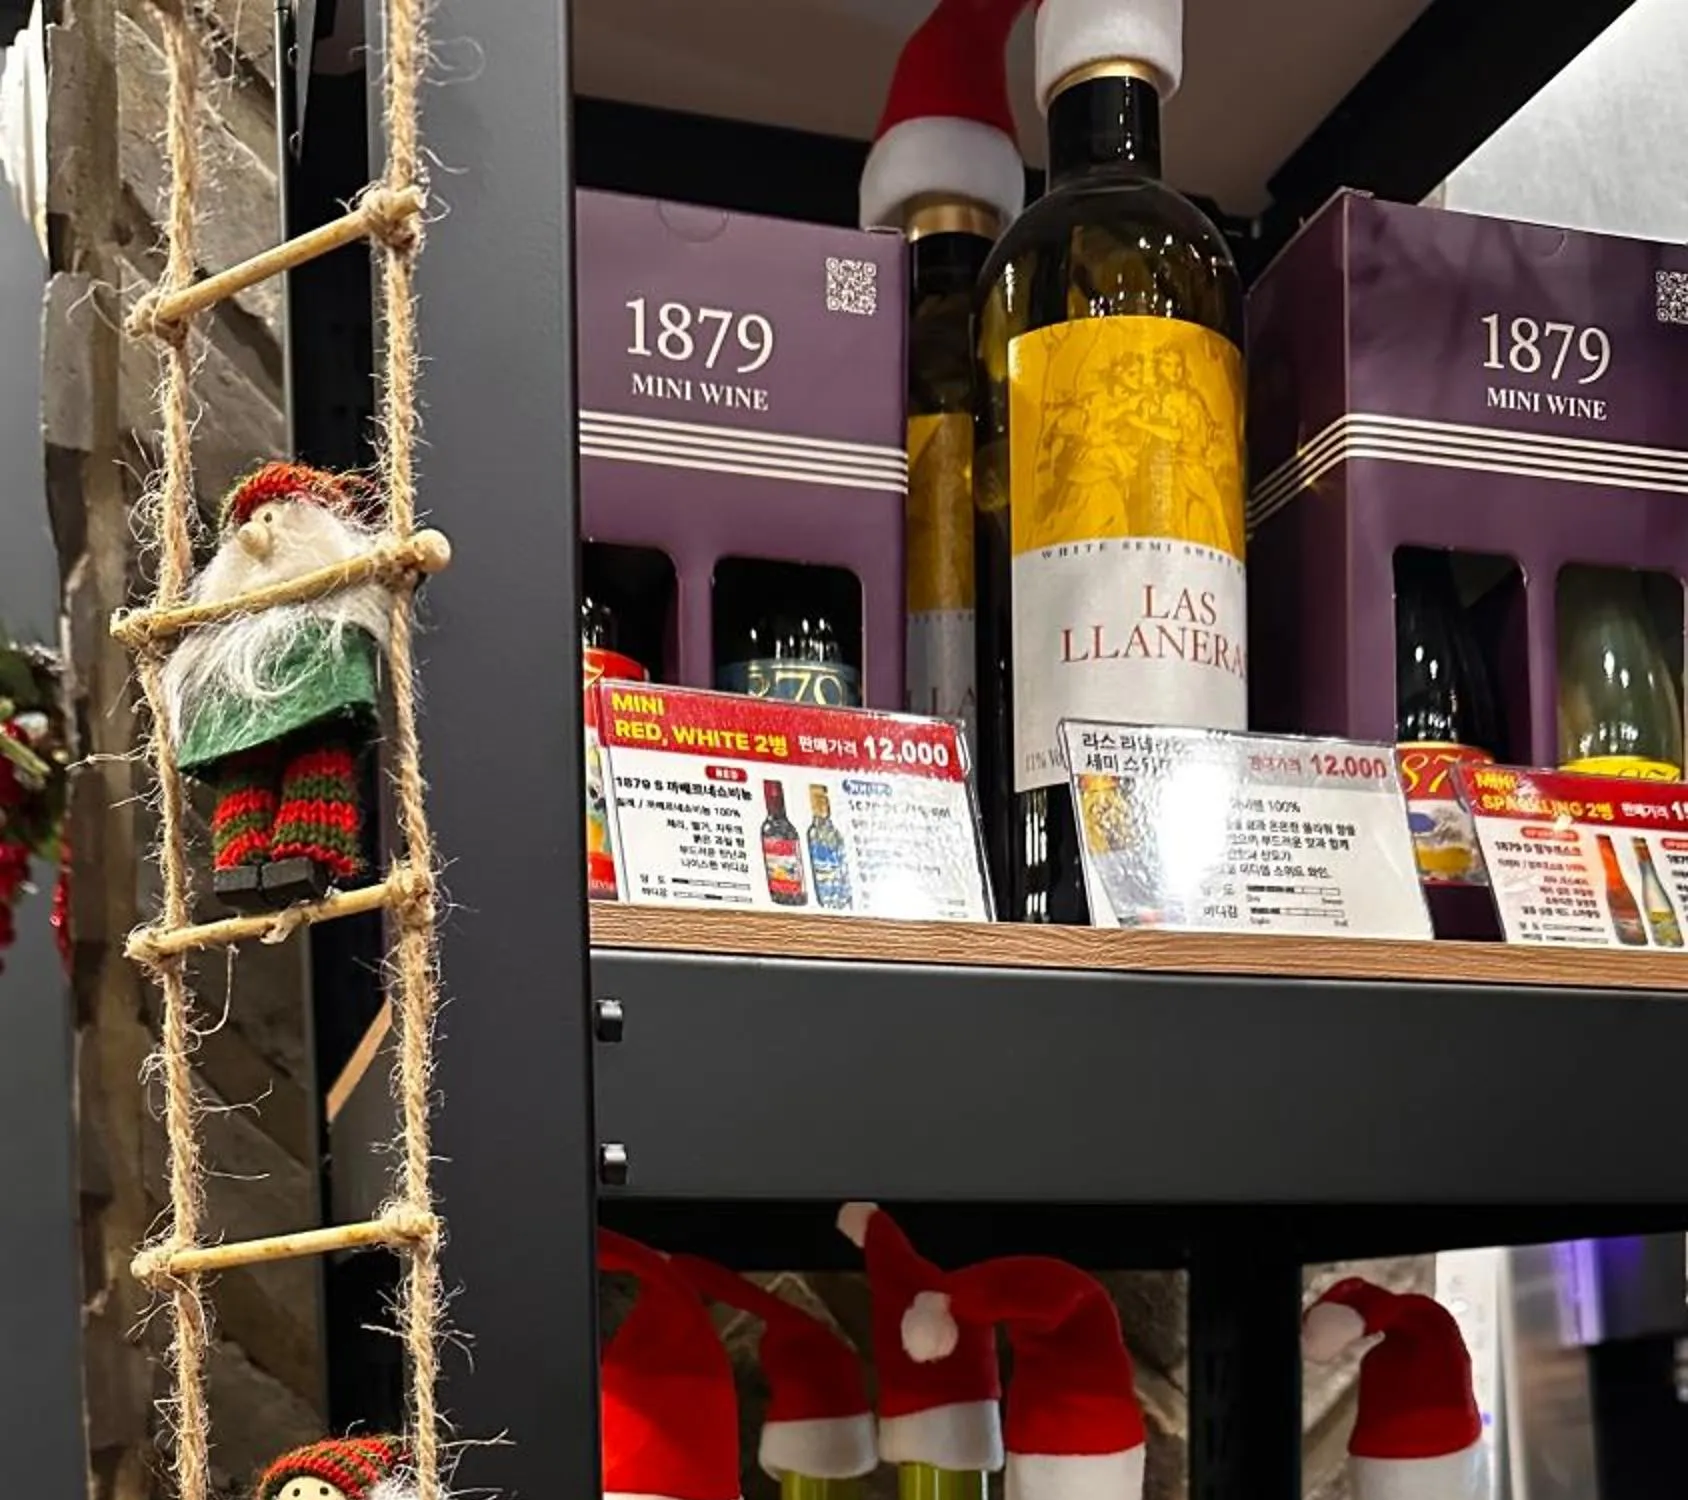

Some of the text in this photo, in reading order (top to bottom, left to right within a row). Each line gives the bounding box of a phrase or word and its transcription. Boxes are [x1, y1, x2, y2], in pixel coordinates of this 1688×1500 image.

[625, 297, 774, 374] 1879
[1481, 312, 1612, 385] 1879
[632, 372, 769, 412] MINI WINE
[1487, 387, 1608, 420] MINI WINE
[1144, 584, 1217, 625] LAS
[612, 691, 664, 716] MINI
[615, 719, 949, 766] RED, WHITE 2병 판매가격 12,000
[1082, 733, 1117, 750] 라스
[1086, 754, 1118, 772] 세미
[615, 777, 651, 790] 1879
[1671, 801, 1688, 822] 1
